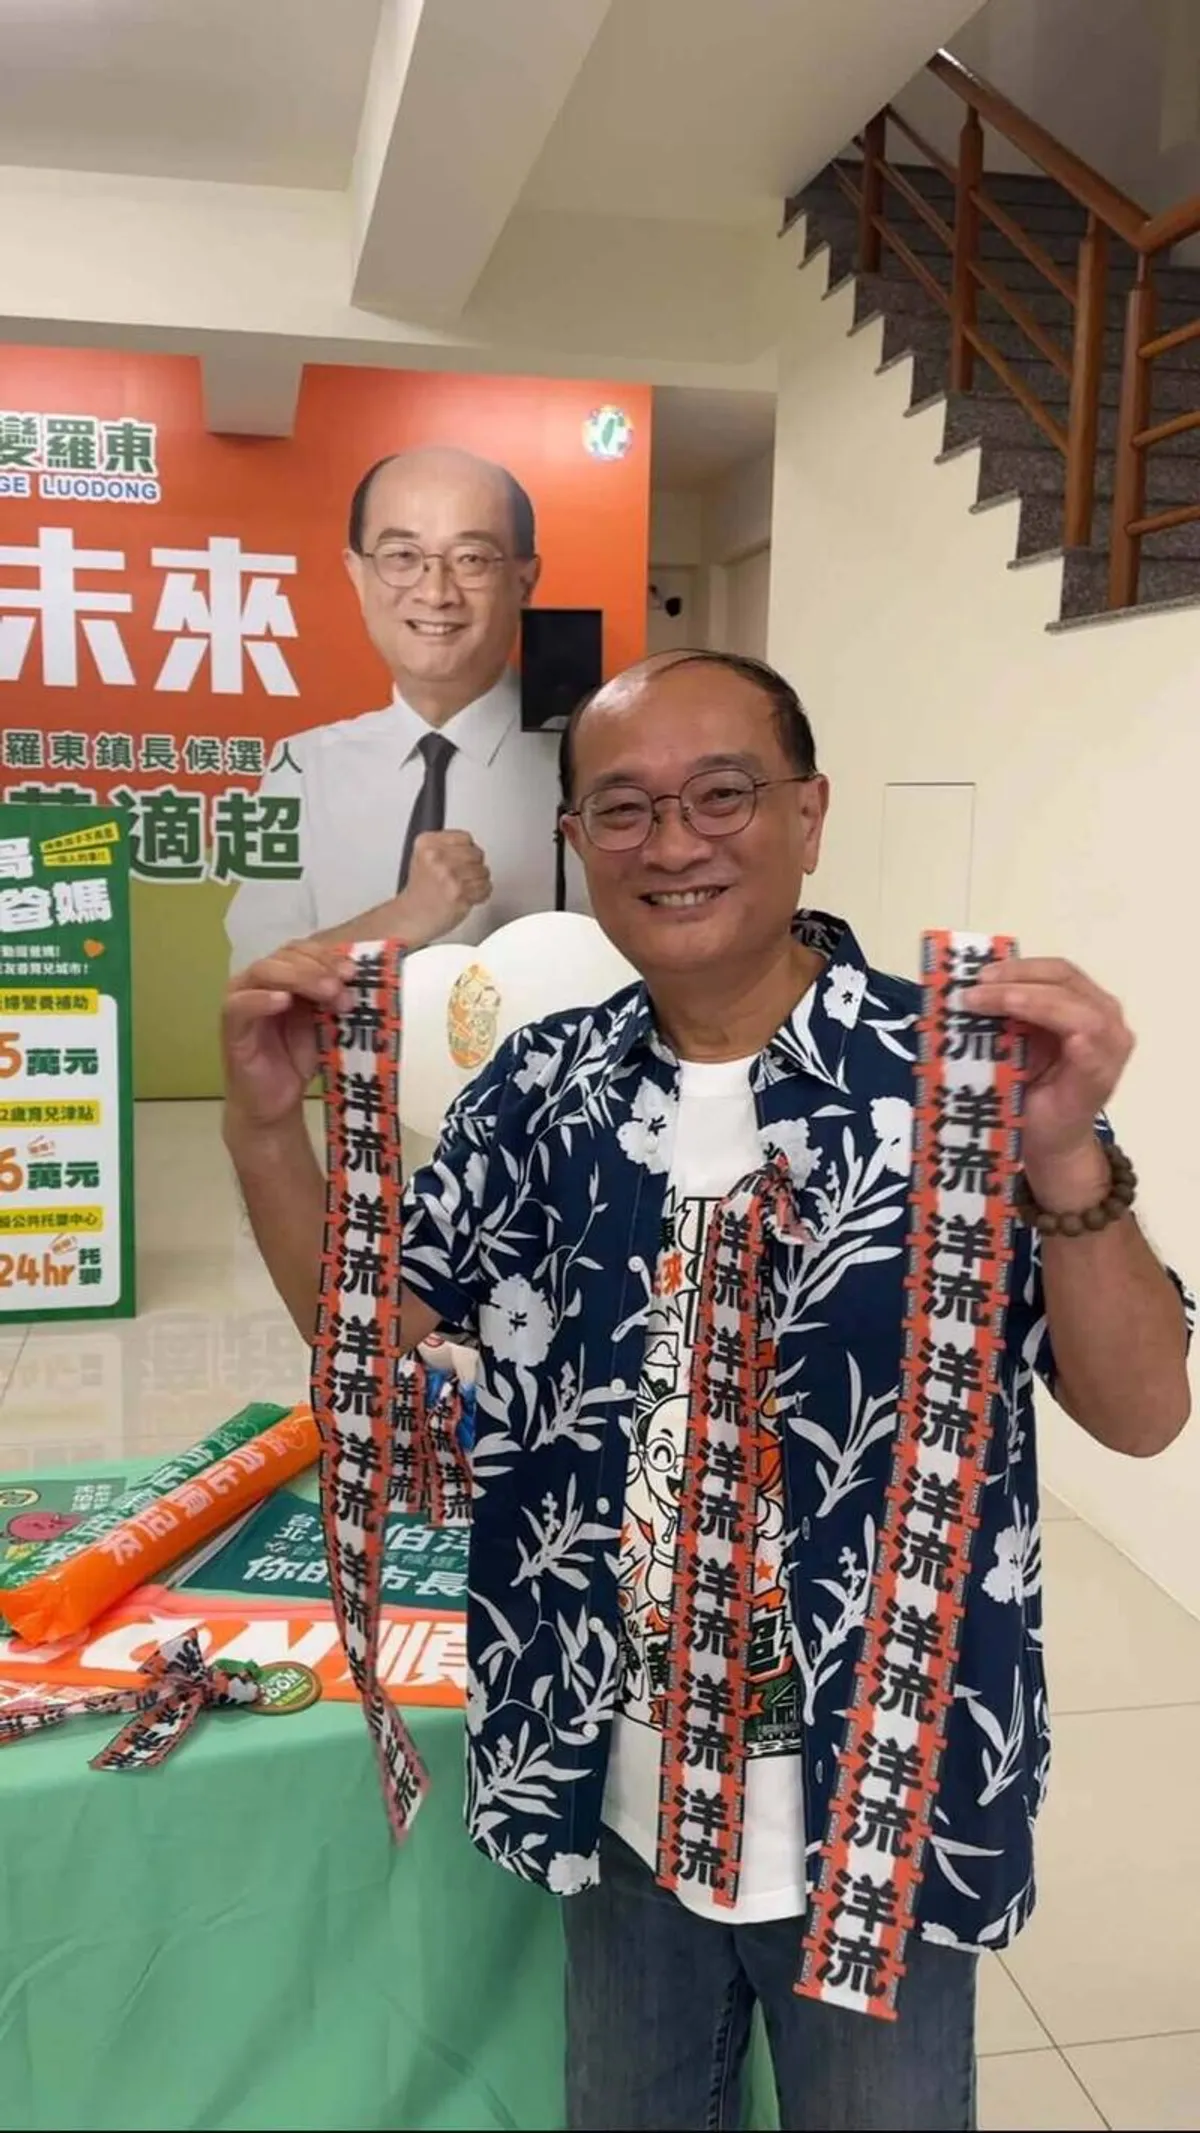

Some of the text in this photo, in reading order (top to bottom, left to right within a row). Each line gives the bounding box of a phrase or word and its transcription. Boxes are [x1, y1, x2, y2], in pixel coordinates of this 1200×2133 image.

[0, 414, 155, 473] 變羅東
[43, 477, 158, 500] LUODONG
[0, 526, 300, 696] 未來
[3, 731, 303, 775] 羅東鎮長候選人
[8, 786, 303, 883] 適超
[0, 878, 112, 932] 爸媽
[0, 994, 89, 1011] 婦營養補助
[336, 1072, 390, 1175] 洋流
[929, 1083, 1005, 1197] 洋流
[334, 1192, 390, 1297] 洋流
[710, 1209, 751, 1306] 洋流
[921, 1213, 997, 1327] 洋流
[325, 1315, 384, 1420] 洋流
[702, 1324, 749, 1428] 洋流
[911, 1337, 984, 1459] 洋流
[328, 1429, 383, 1533] 洋流
[691, 1438, 749, 1544] 洋流
[891, 1466, 966, 1593] 洋流
[682, 1552, 740, 1660] 洋流
[868, 1597, 944, 1724] 洋流
[676, 1670, 734, 1775] 洋流
[669, 1782, 728, 1892] 洋流
[842, 1730, 925, 1858] 洋流
[815, 1869, 900, 1997] 洋流
